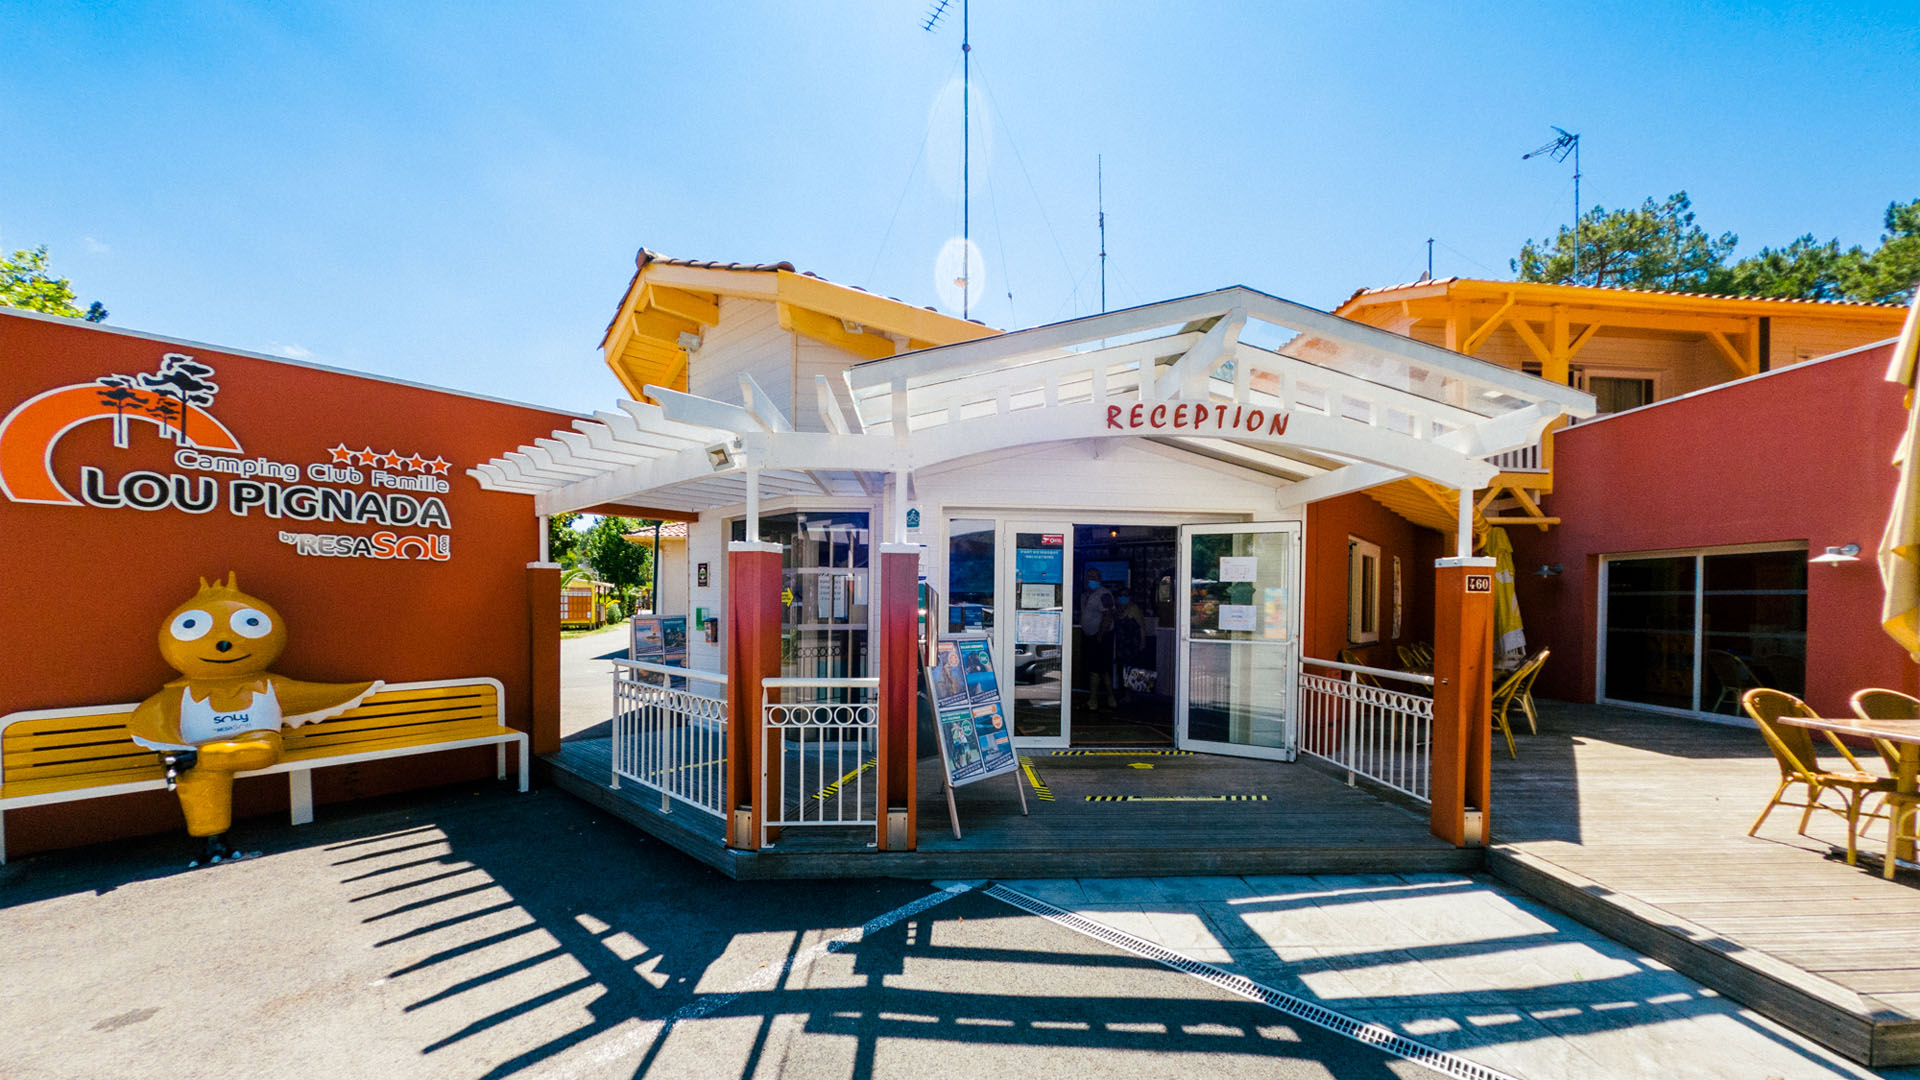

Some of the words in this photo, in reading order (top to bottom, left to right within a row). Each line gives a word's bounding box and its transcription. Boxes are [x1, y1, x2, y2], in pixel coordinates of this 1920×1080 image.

[1107, 404, 1289, 435] RECEPTION
[175, 450, 298, 481] Camping
[308, 464, 363, 484] Club
[371, 470, 449, 493] Famille
[82, 467, 217, 512] LOU
[230, 481, 451, 529] PIGNADA
[279, 531, 298, 544] by
[1470, 578, 1489, 590] 460
